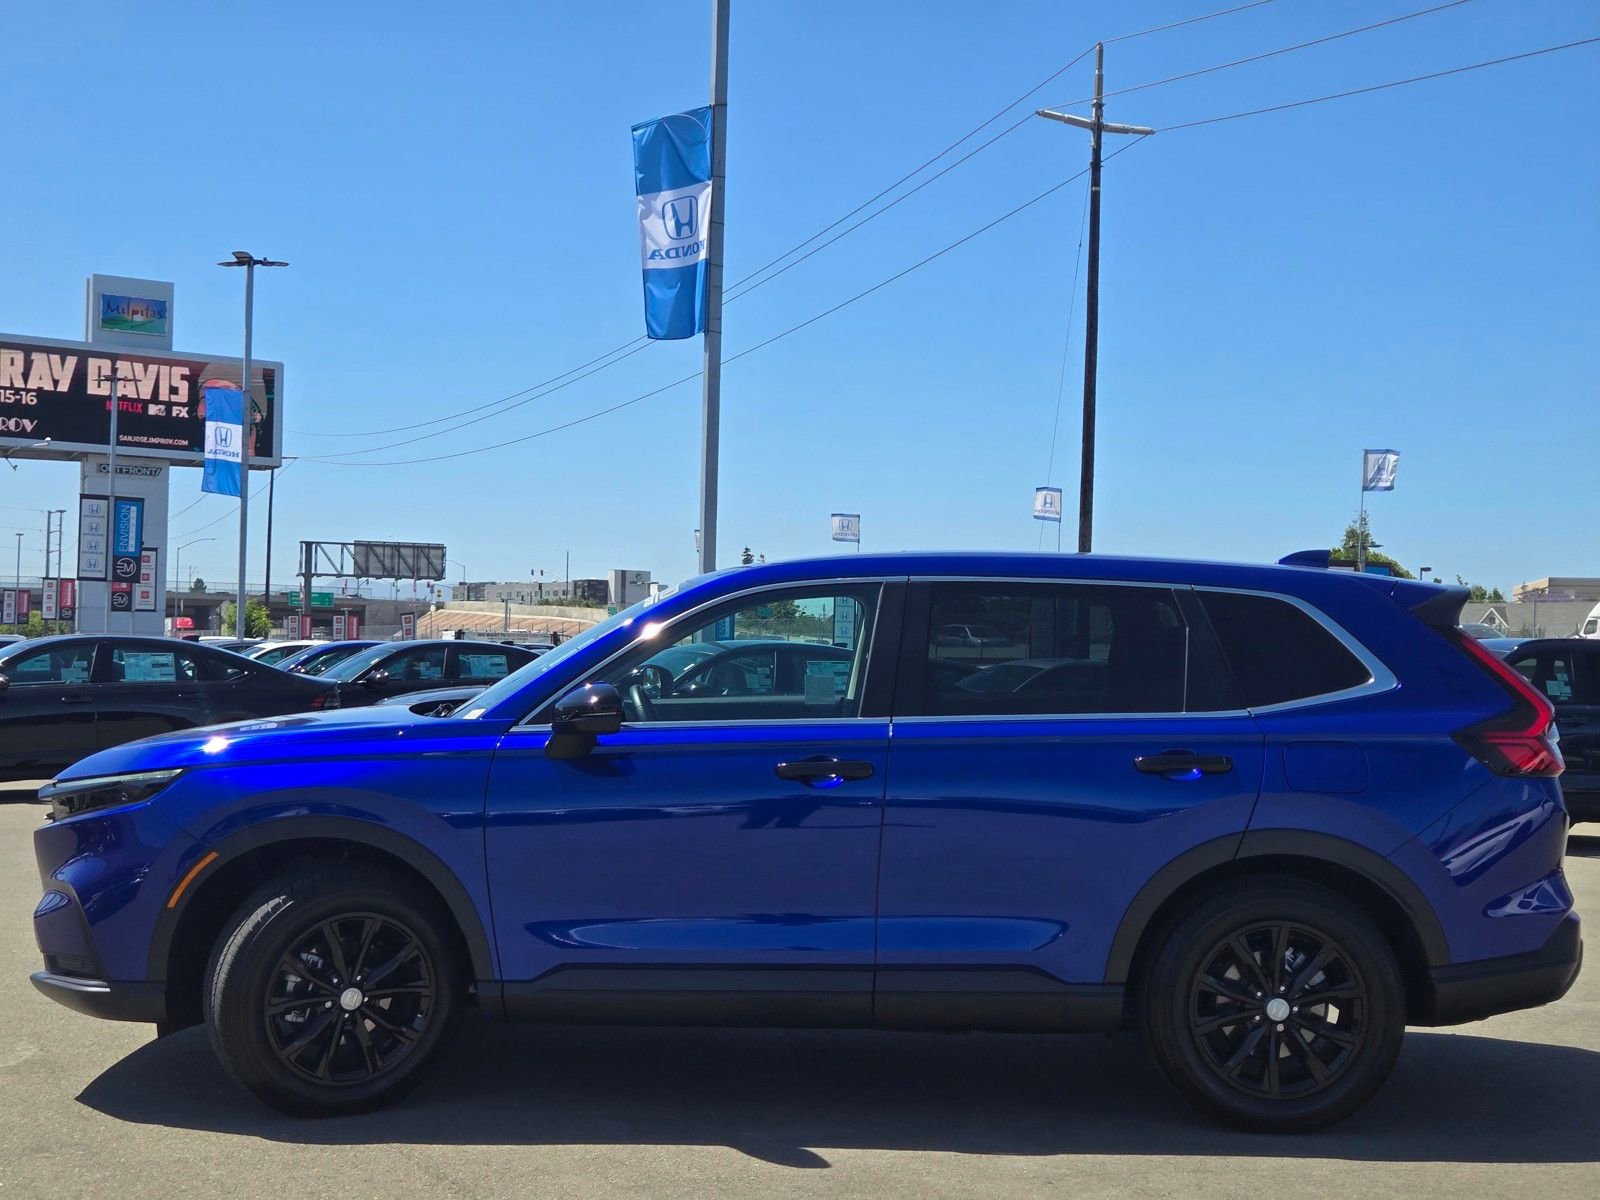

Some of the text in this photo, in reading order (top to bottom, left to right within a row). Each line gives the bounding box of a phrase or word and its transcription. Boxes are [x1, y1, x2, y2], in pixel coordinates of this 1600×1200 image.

[0, 349, 190, 403] RAY DAVIS
[0, 390, 38, 405] 15-16
[106, 400, 143, 414] NTFLIX
[172, 406, 189, 418] FX
[119, 504, 130, 551] ENVISION
